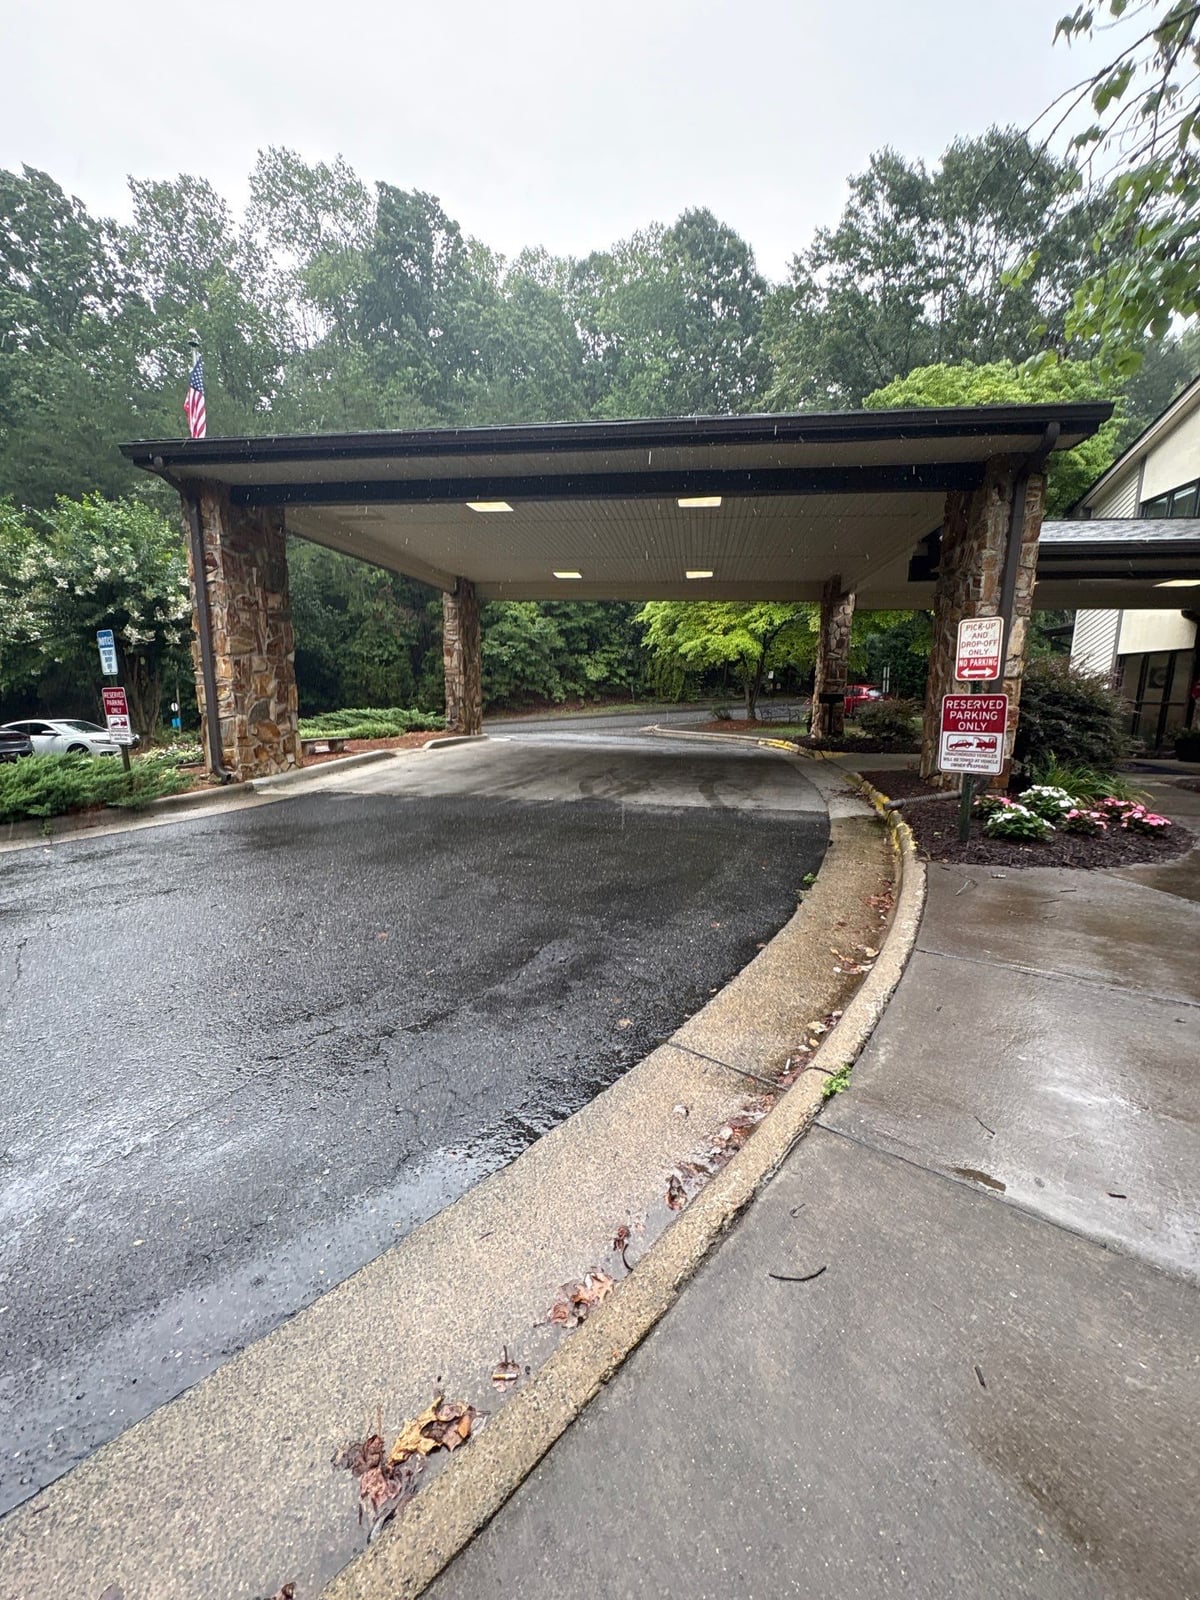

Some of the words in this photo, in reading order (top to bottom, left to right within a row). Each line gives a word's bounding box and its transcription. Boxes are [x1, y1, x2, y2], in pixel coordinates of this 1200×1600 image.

[966, 623, 996, 631] PICK-UP
[961, 639, 998, 648] DROP-OFF
[968, 648, 989, 656] ONLY
[959, 659, 969, 667] NO
[970, 658, 998, 667] PARKING
[946, 700, 1004, 709] RESERVED
[950, 711, 998, 720] PARKING
[958, 721, 987, 731] ONLY
